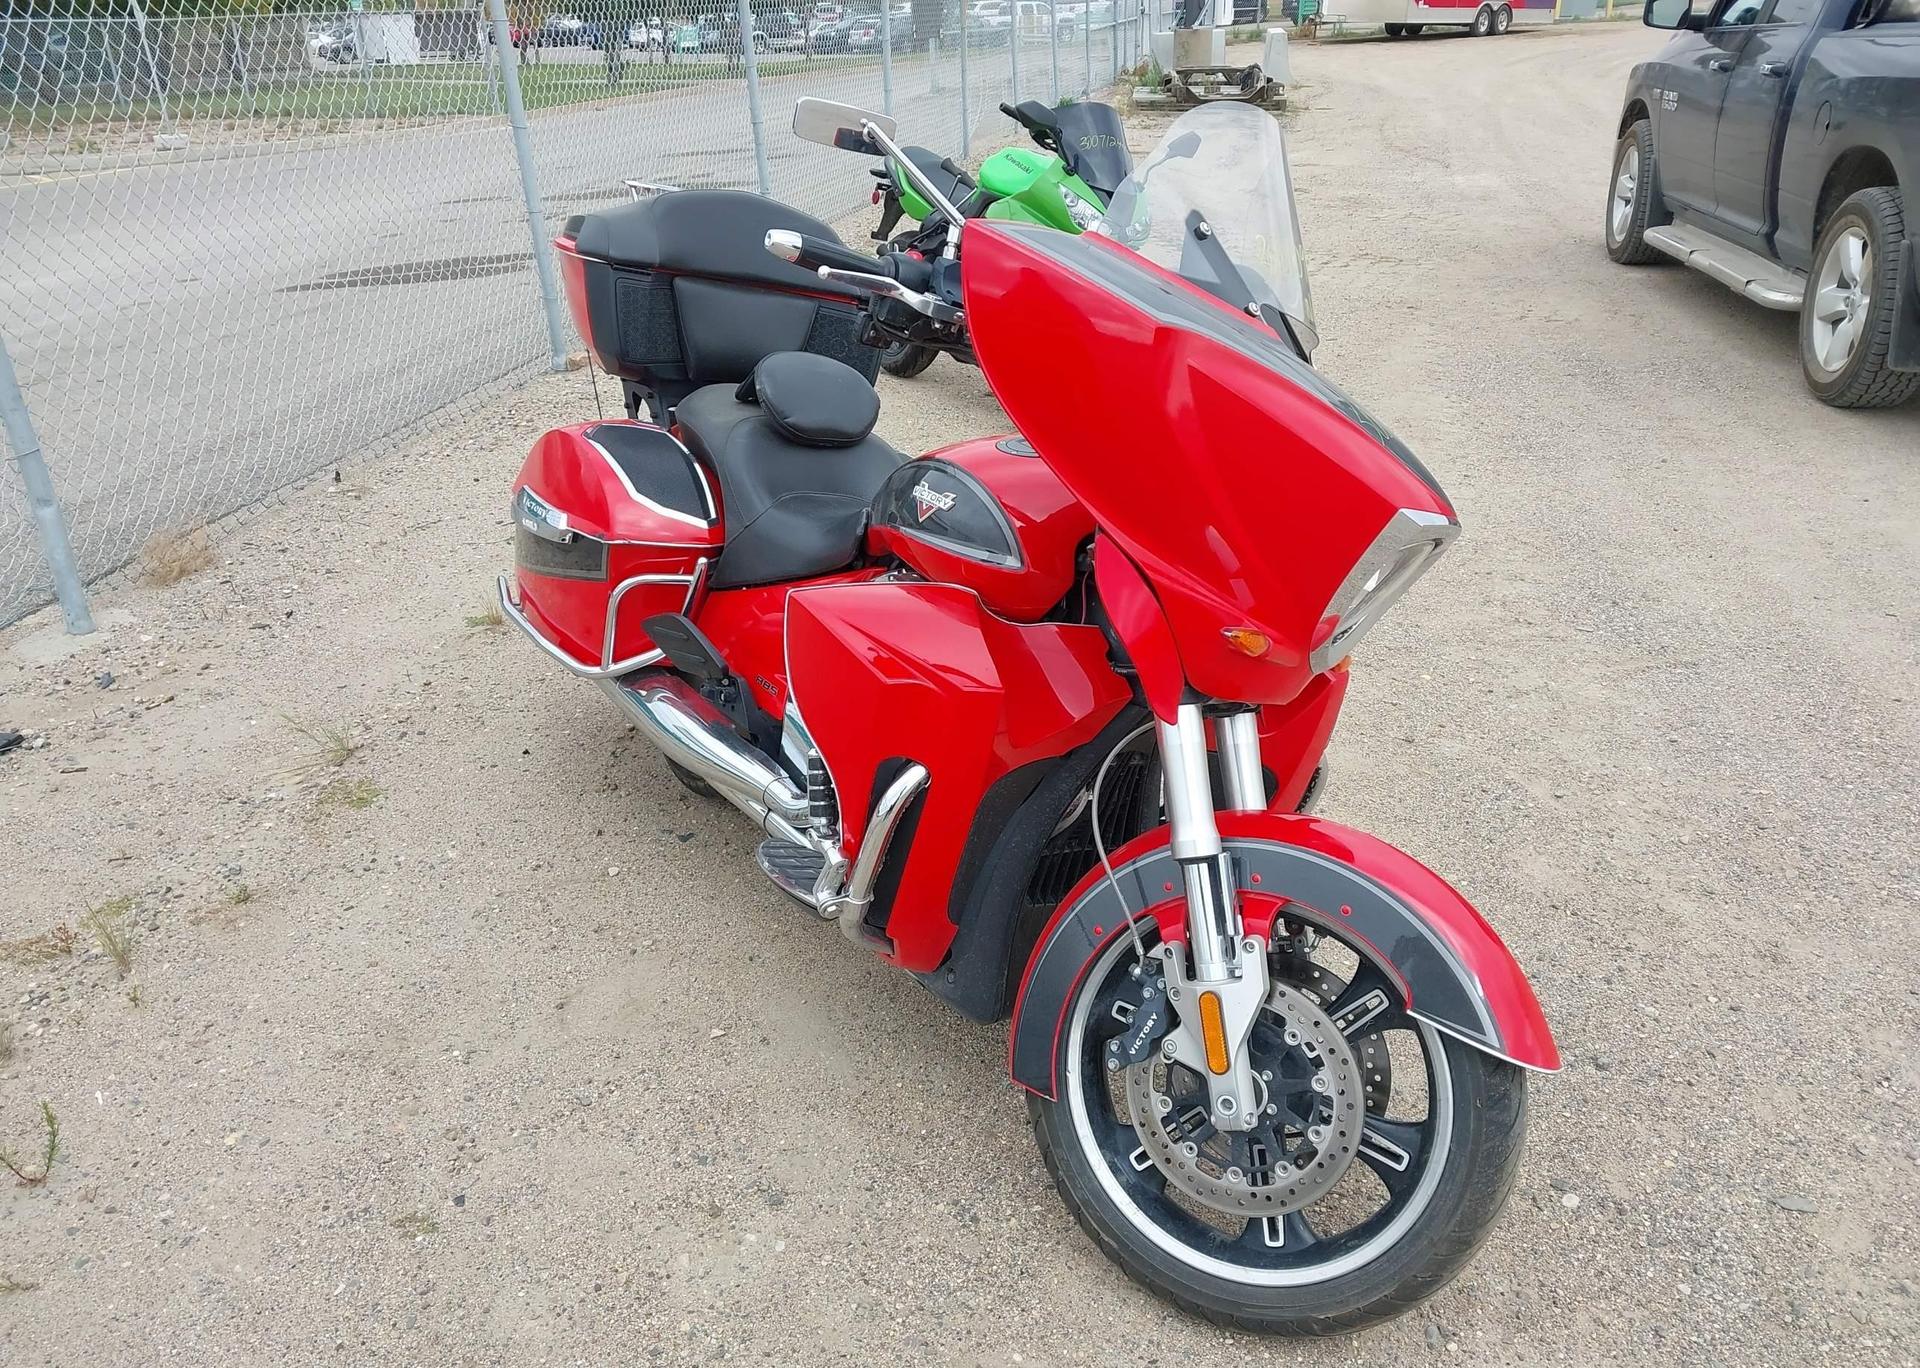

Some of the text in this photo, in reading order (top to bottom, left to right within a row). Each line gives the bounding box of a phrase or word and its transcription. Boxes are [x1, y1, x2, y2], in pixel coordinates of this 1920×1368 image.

[1004, 153, 1035, 175] Kawasaki
[913, 484, 954, 509] VICTORY
[755, 673, 780, 697] ABS
[1129, 1011, 1158, 1055] VICTORY
